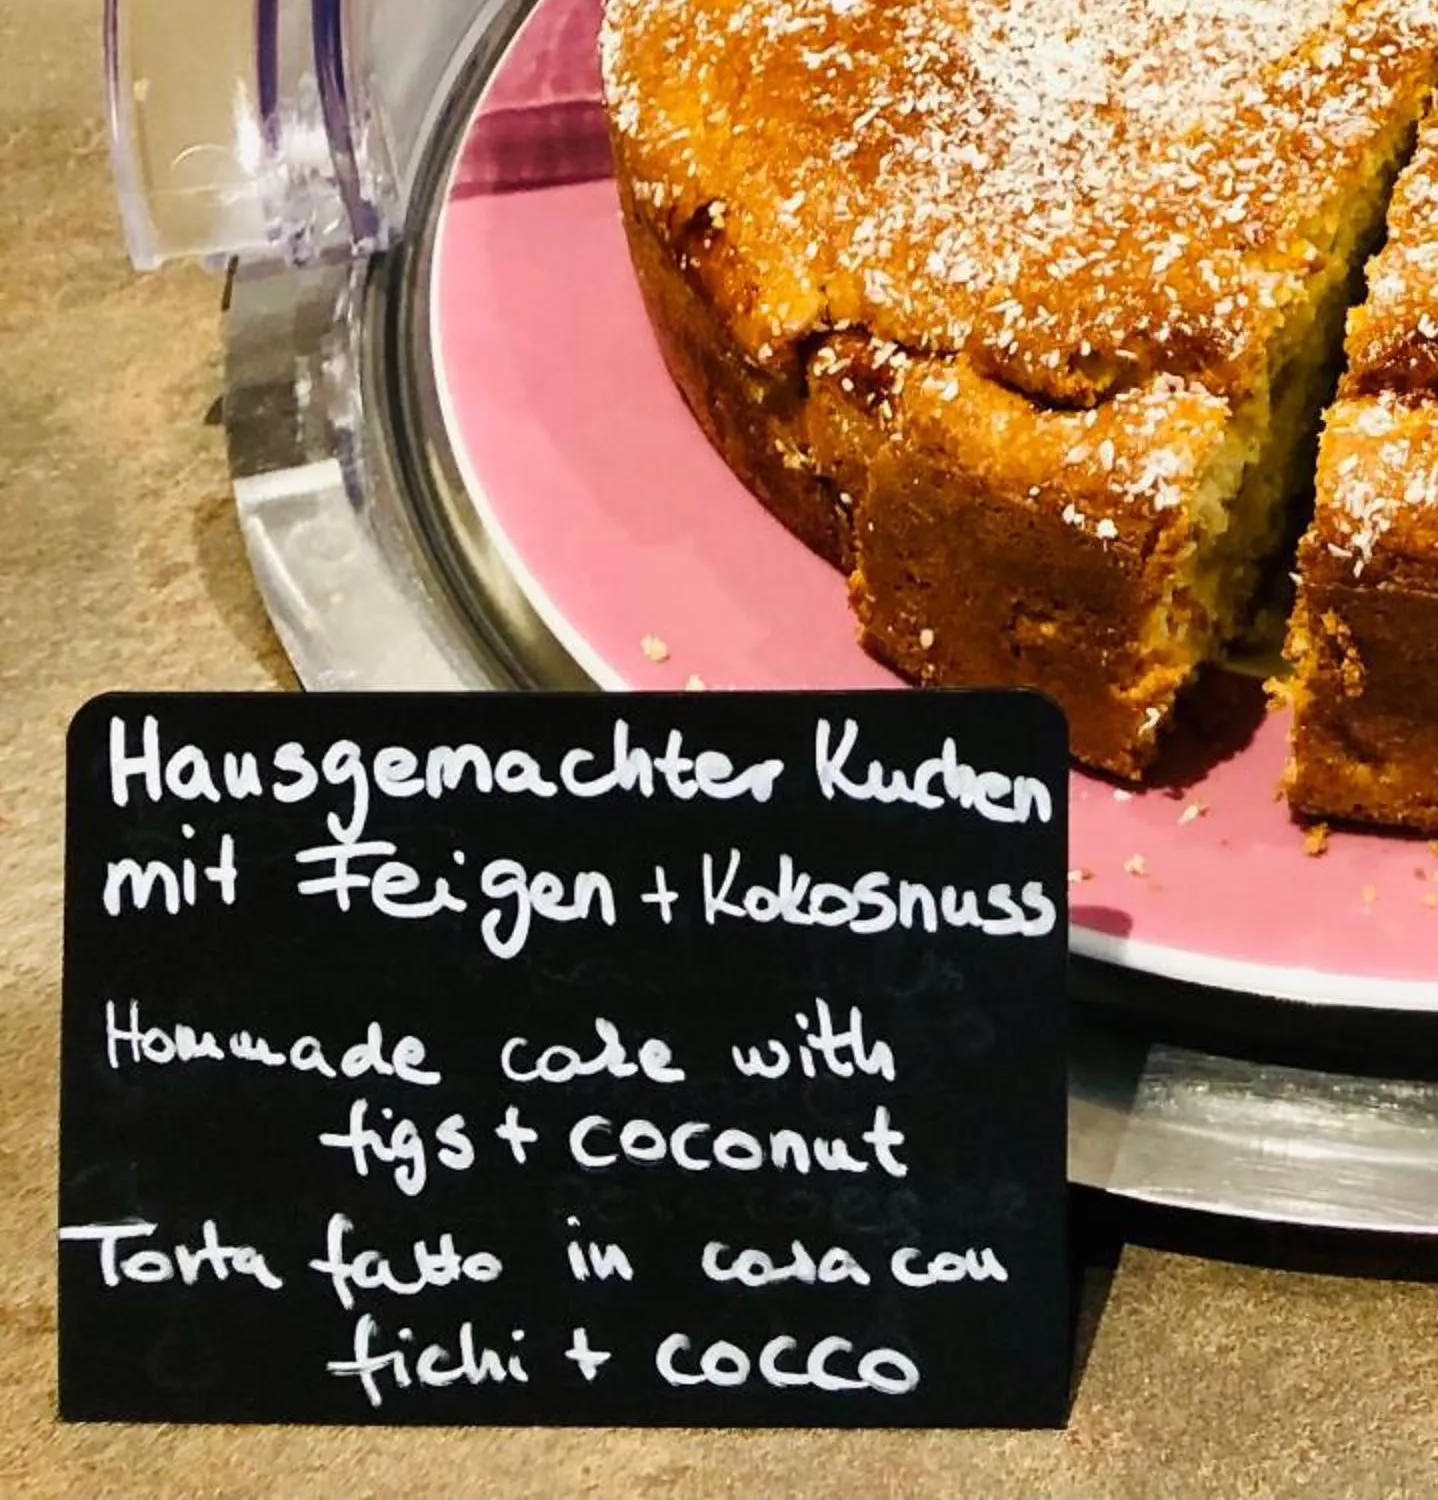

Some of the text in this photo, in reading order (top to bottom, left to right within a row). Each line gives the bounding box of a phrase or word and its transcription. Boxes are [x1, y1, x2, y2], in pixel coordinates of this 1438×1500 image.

[108, 715, 1053, 840] Hausgemachter Kuchen
[102, 823, 238, 917] mit
[296, 840, 616, 960] Feigen
[702, 847, 1058, 937] Kokosnuss
[732, 997, 896, 1082] with
[319, 1098, 476, 1197] figs
[494, 1104, 539, 1164] +
[60, 1220, 284, 1291] Torta
[566, 1215, 635, 1282] in
[327, 1313, 530, 1407] fichi
[564, 1327, 612, 1382] +
